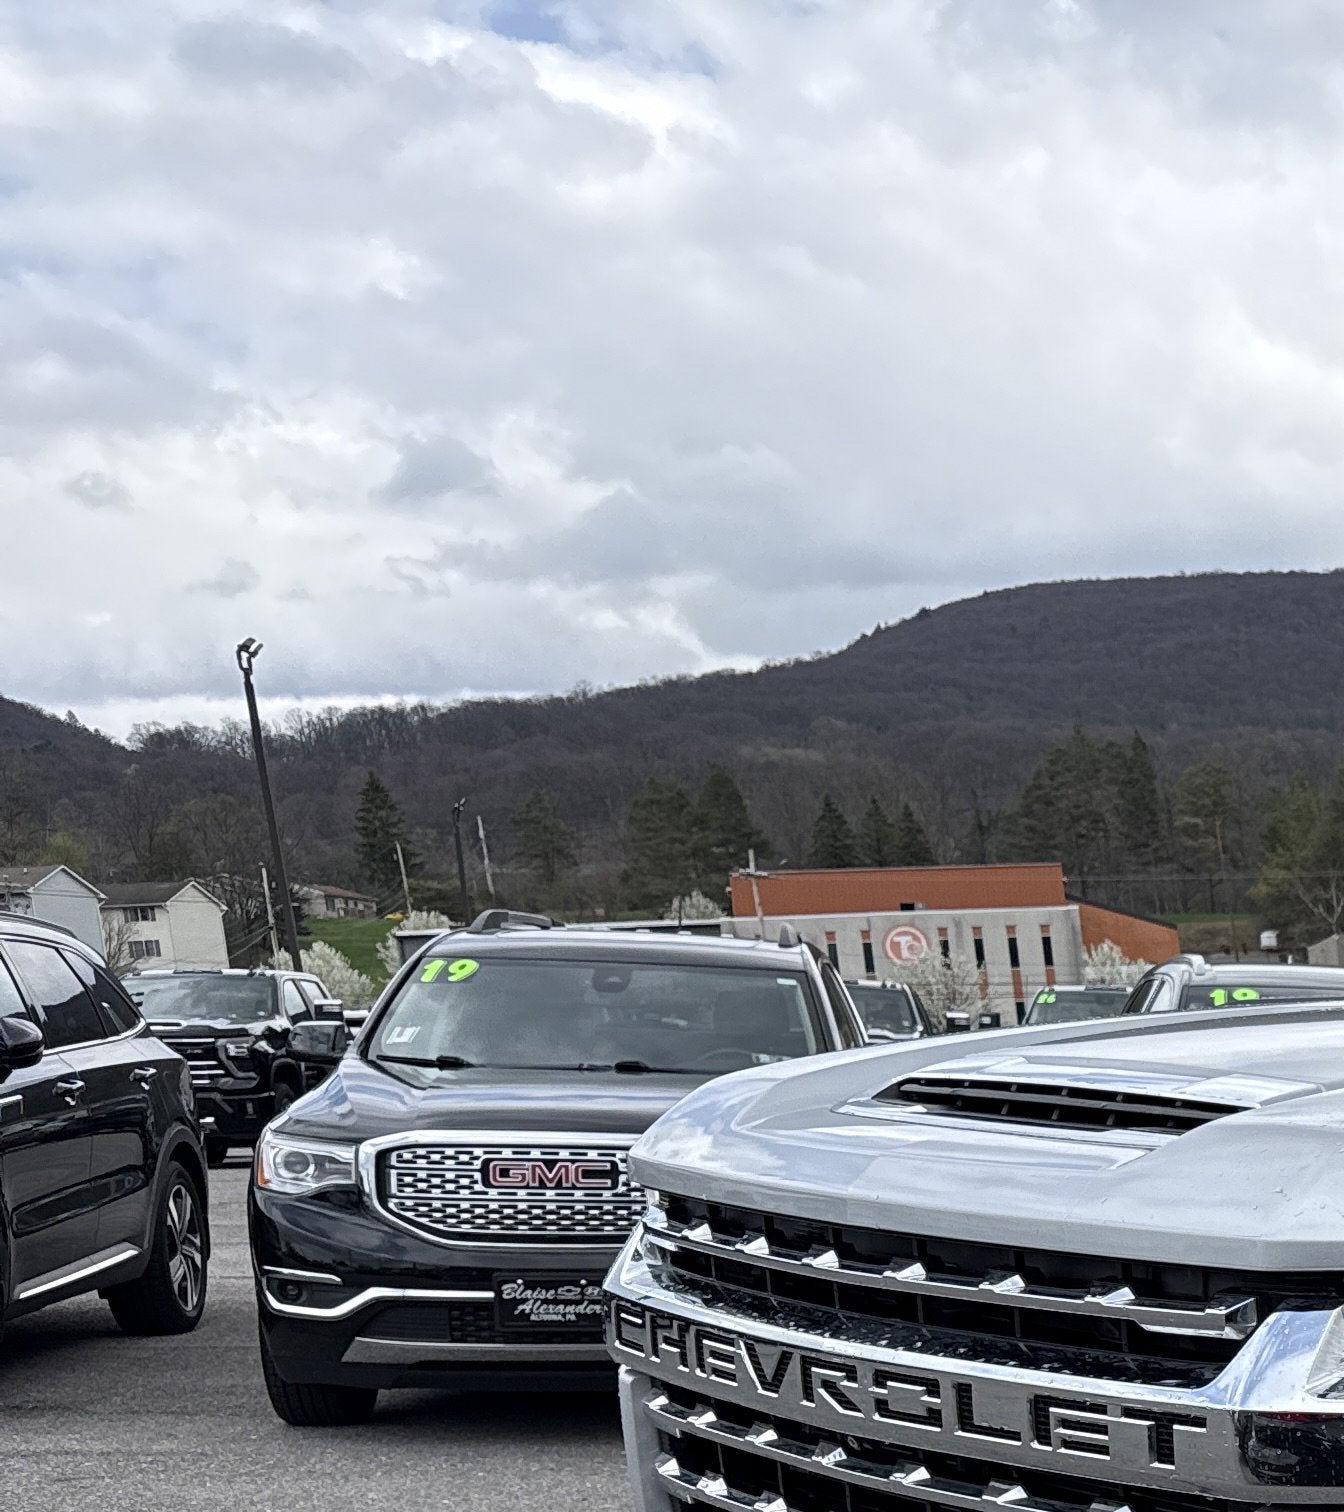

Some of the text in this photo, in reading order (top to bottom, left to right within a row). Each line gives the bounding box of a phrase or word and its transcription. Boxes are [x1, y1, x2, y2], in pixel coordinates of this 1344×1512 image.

[420, 958, 479, 982] 19
[489, 1160, 612, 1188] GMC
[501, 1283, 556, 1300] Blaise
[513, 1299, 604, 1315] Alexander
[612, 1299, 1208, 1470] CHEVROLET
